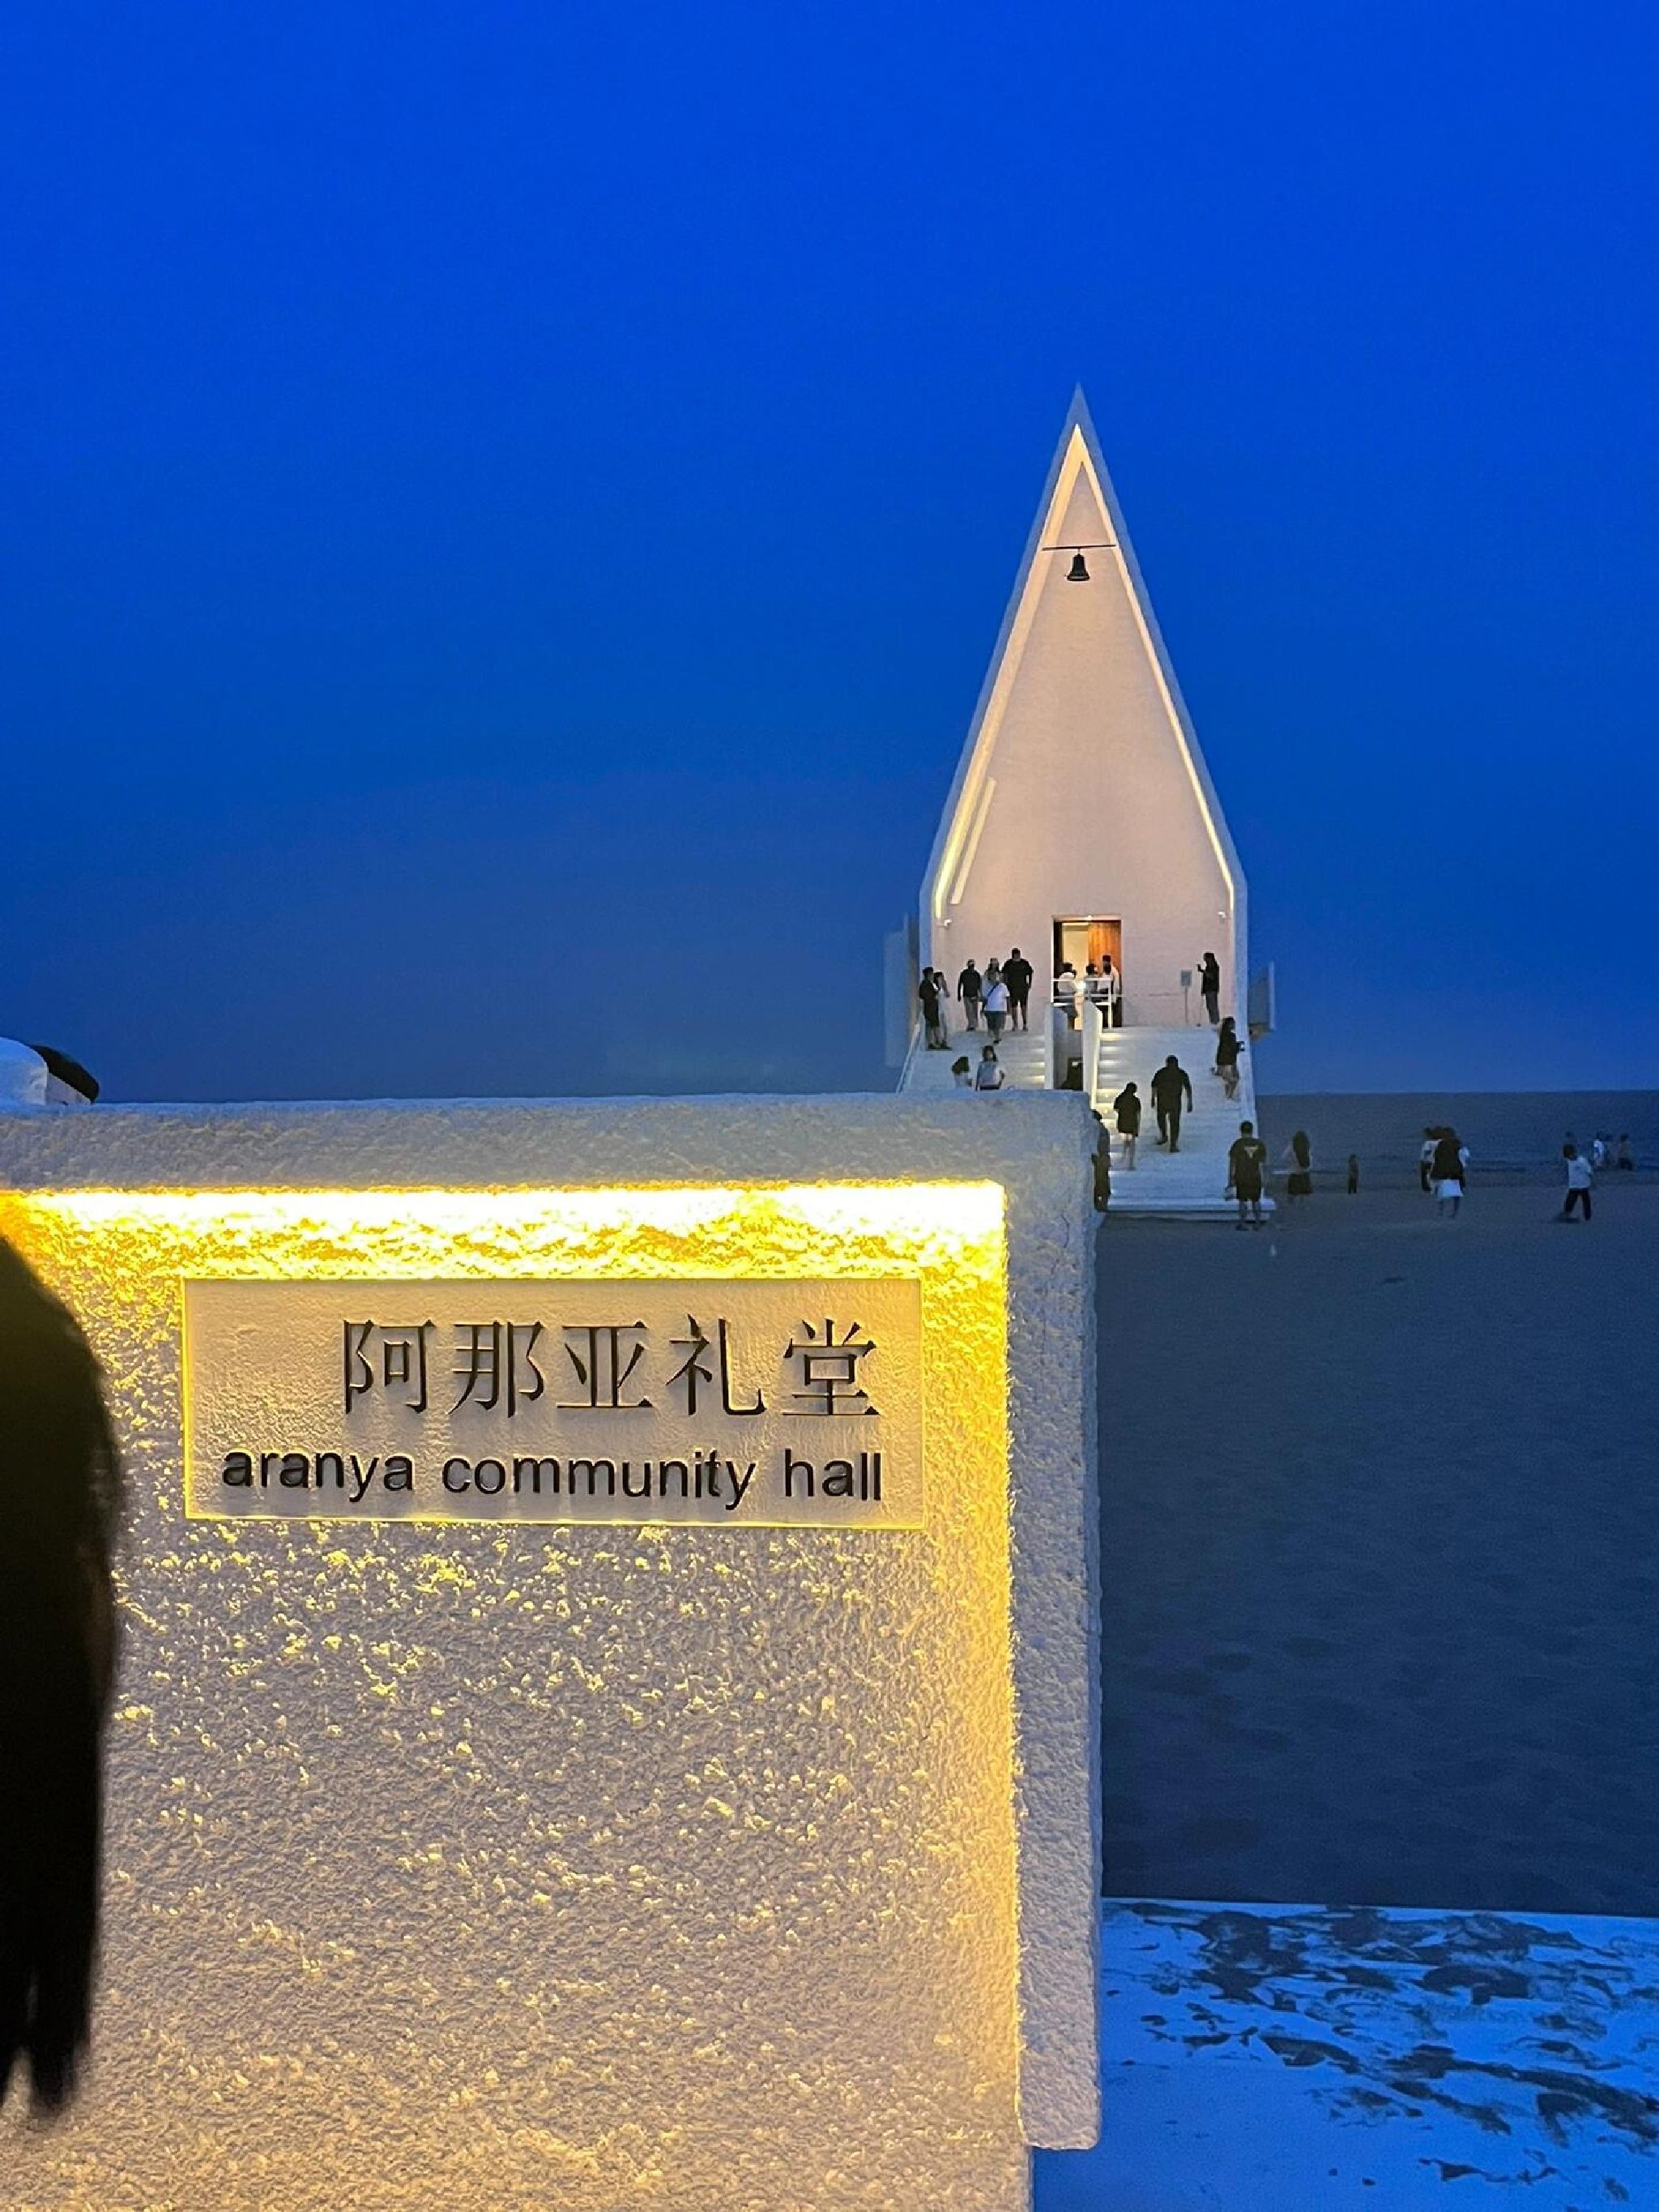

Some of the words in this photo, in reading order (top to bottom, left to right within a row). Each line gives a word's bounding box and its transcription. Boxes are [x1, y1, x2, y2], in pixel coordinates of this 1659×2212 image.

[343, 1313, 881, 1418] 阿那亚礼堂
[222, 1450, 414, 1501] aranya
[441, 1450, 756, 1510] community
[783, 1449, 882, 1501] hall
